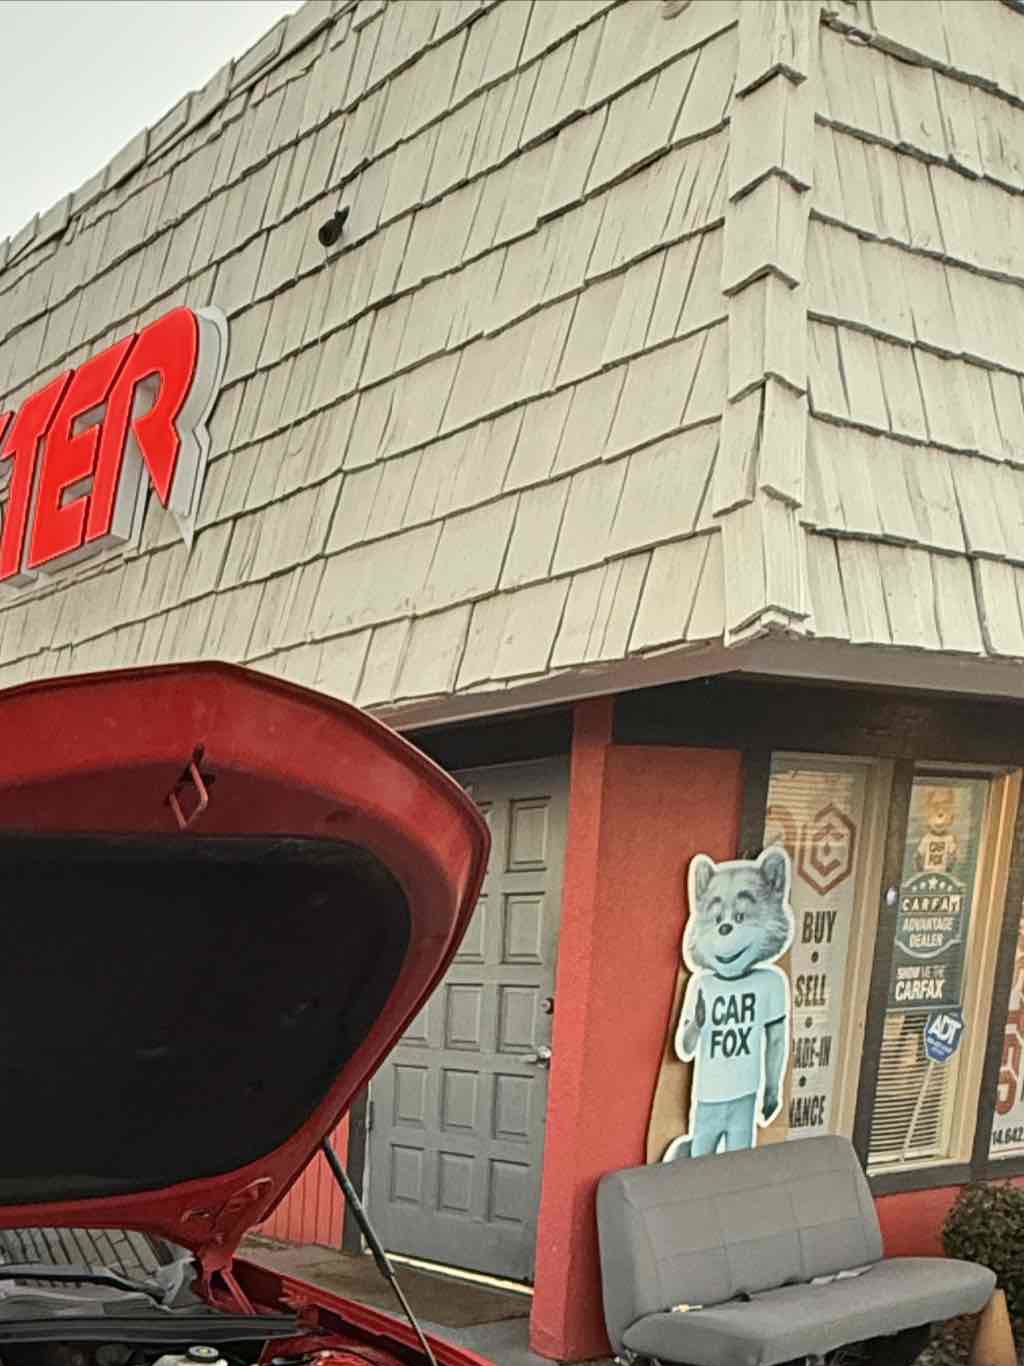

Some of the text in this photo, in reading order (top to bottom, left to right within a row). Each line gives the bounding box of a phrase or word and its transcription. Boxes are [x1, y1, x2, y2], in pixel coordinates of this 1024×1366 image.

[801, 910, 837, 944] BUY
[902, 917, 954, 931] ADVANTAGE
[794, 974, 826, 1008] SELL
[895, 978, 945, 1001] CARFAX
[711, 993, 756, 1026] CAR
[709, 1027, 753, 1059] FOX
[927, 1013, 962, 1045] ADT
[792, 1035, 832, 1068] ADE-IN
